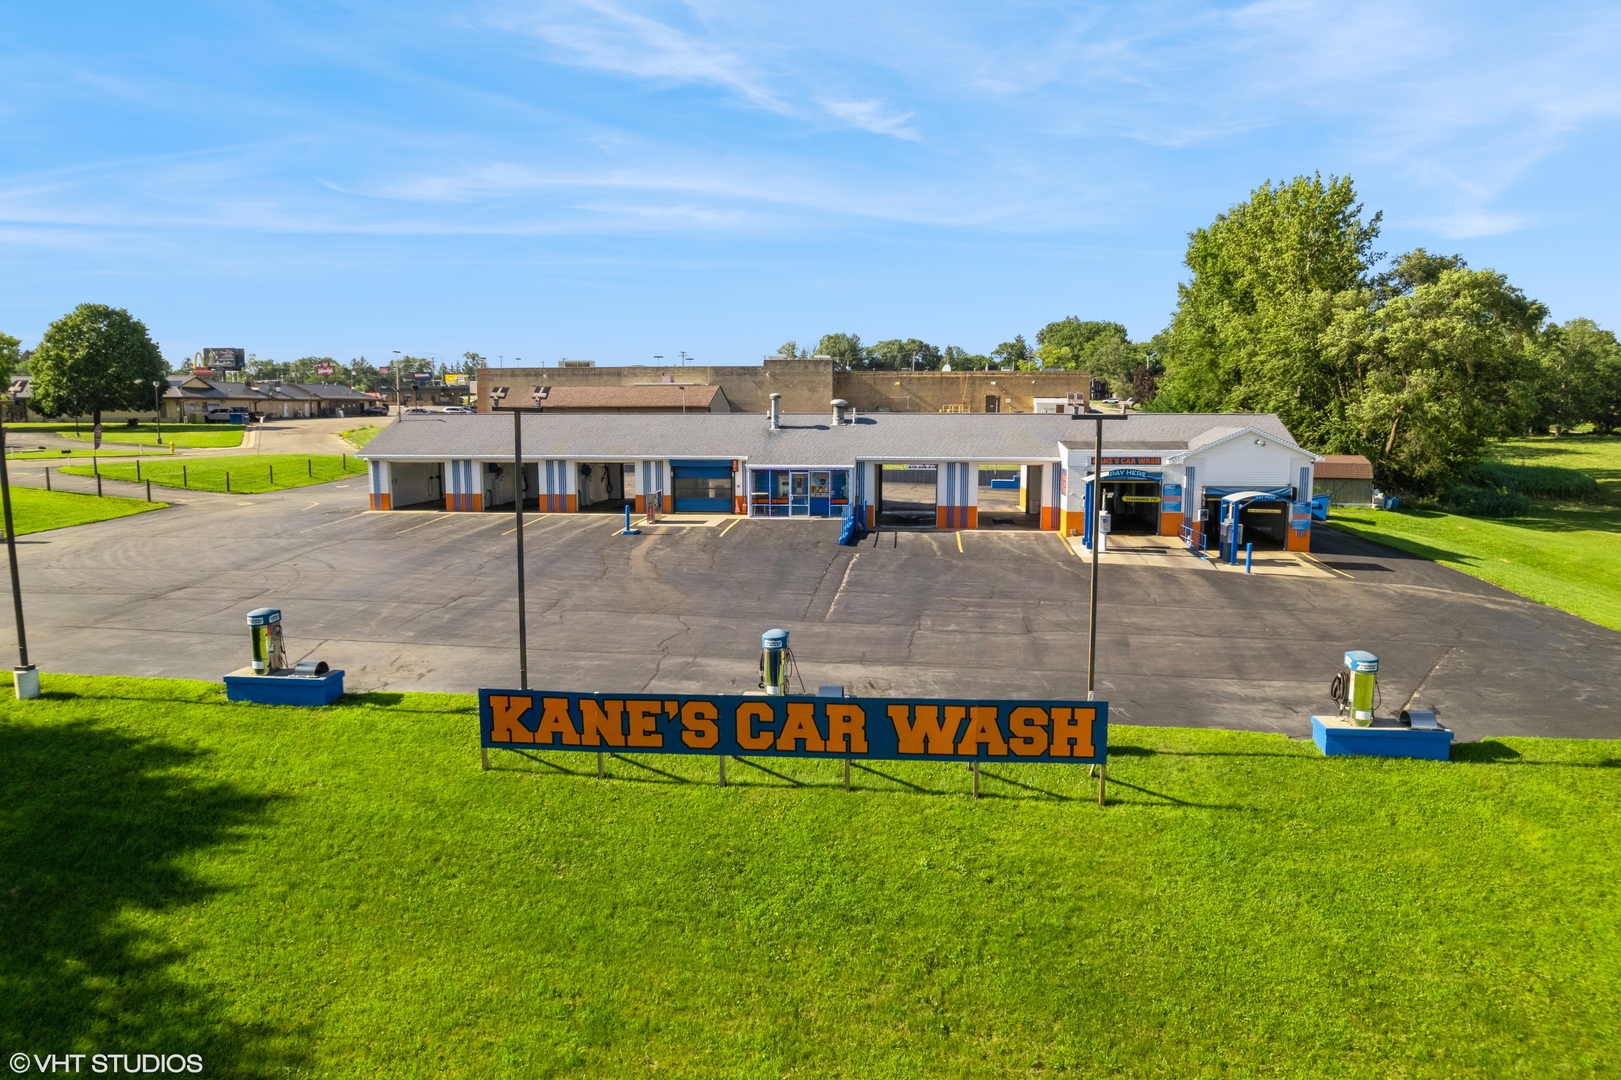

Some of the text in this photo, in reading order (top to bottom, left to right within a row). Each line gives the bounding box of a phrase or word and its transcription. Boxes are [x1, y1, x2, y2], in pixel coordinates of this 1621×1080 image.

[1109, 469, 1147, 478] PAY HERE
[488, 694, 1097, 758] KANE'S CAR WASH
